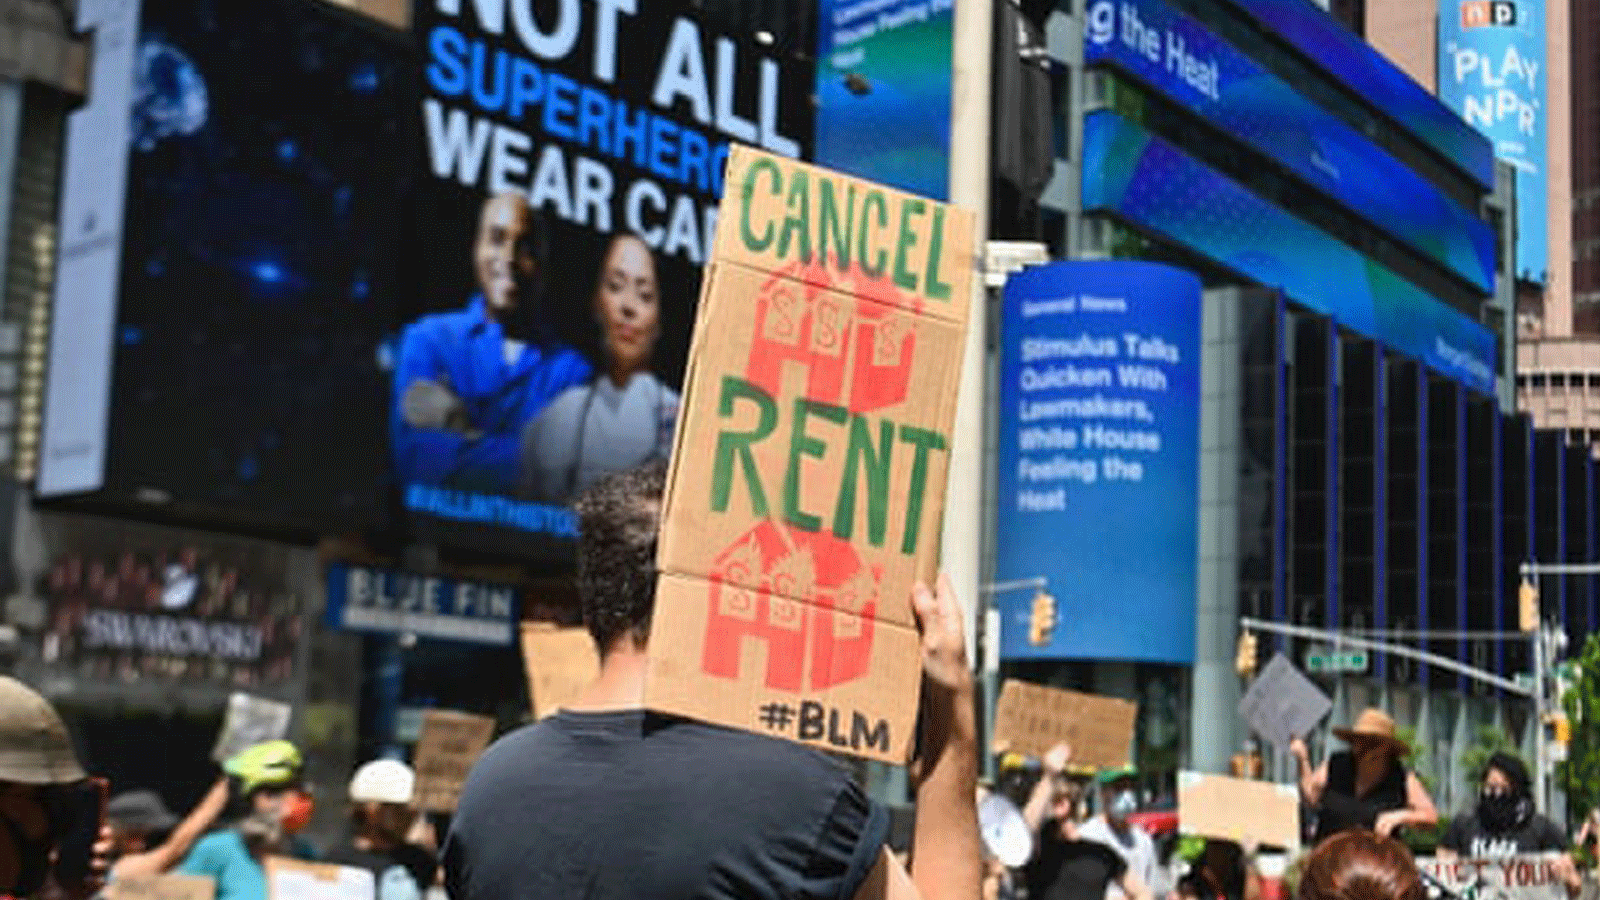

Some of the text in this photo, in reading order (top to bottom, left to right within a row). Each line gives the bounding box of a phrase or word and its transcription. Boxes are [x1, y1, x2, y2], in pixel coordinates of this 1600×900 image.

[1121, 2, 1162, 62] the
[1166, 31, 1219, 101] Heat
[436, 0, 802, 158] OT ALL
[424, 100, 613, 232] WEAR
[739, 157, 953, 302] CANCEL
[1022, 333, 1180, 363] Stimulus Talks
[1021, 364, 1168, 390] Quicken With
[1083, 424, 1160, 452] House
[711, 375, 946, 556] RENT
[1019, 455, 1143, 483] Feeling the
[454, 584, 512, 617] FIN
[759, 699, 890, 753] #BLM
